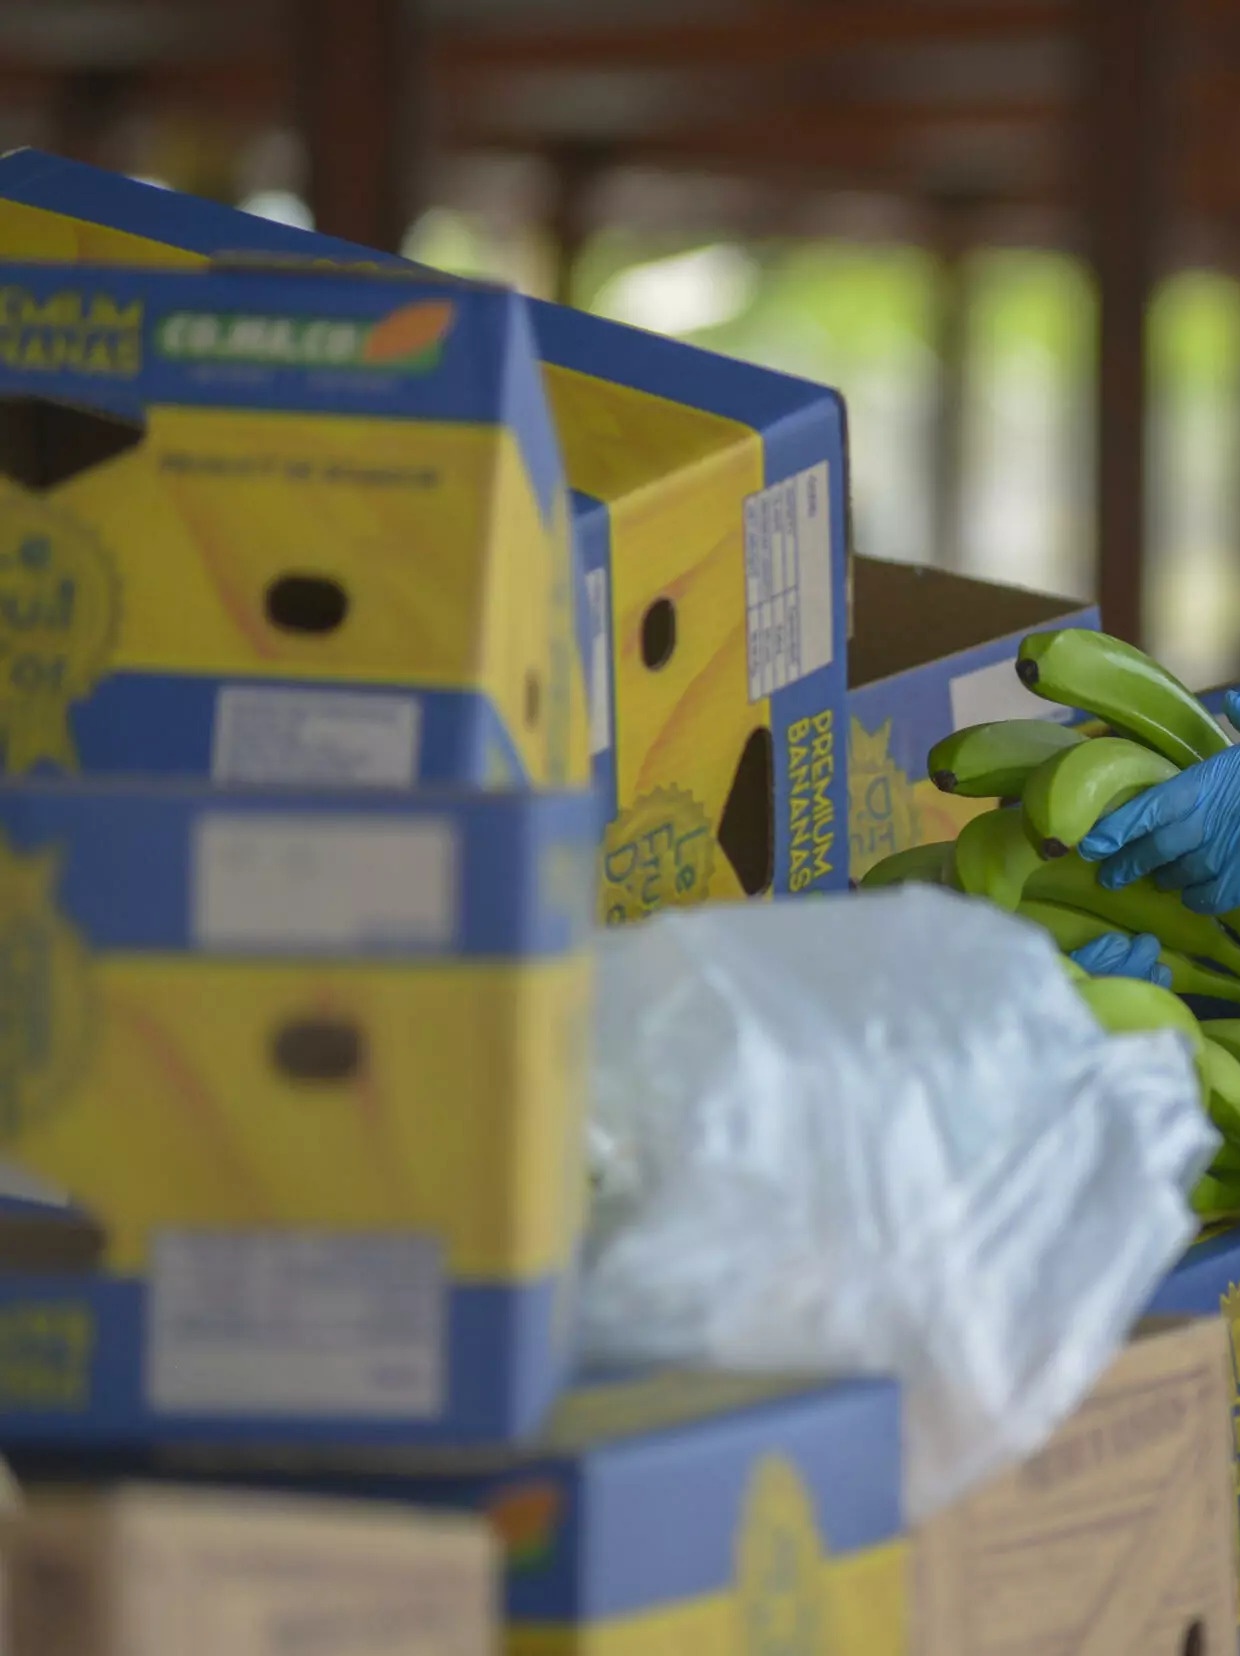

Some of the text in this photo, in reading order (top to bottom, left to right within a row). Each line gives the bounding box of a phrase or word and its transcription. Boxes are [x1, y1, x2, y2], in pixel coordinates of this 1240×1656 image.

[675, 824, 709, 895] Le
[787, 716, 812, 893] BANANAS
[811, 708, 835, 879] PREMIUM
